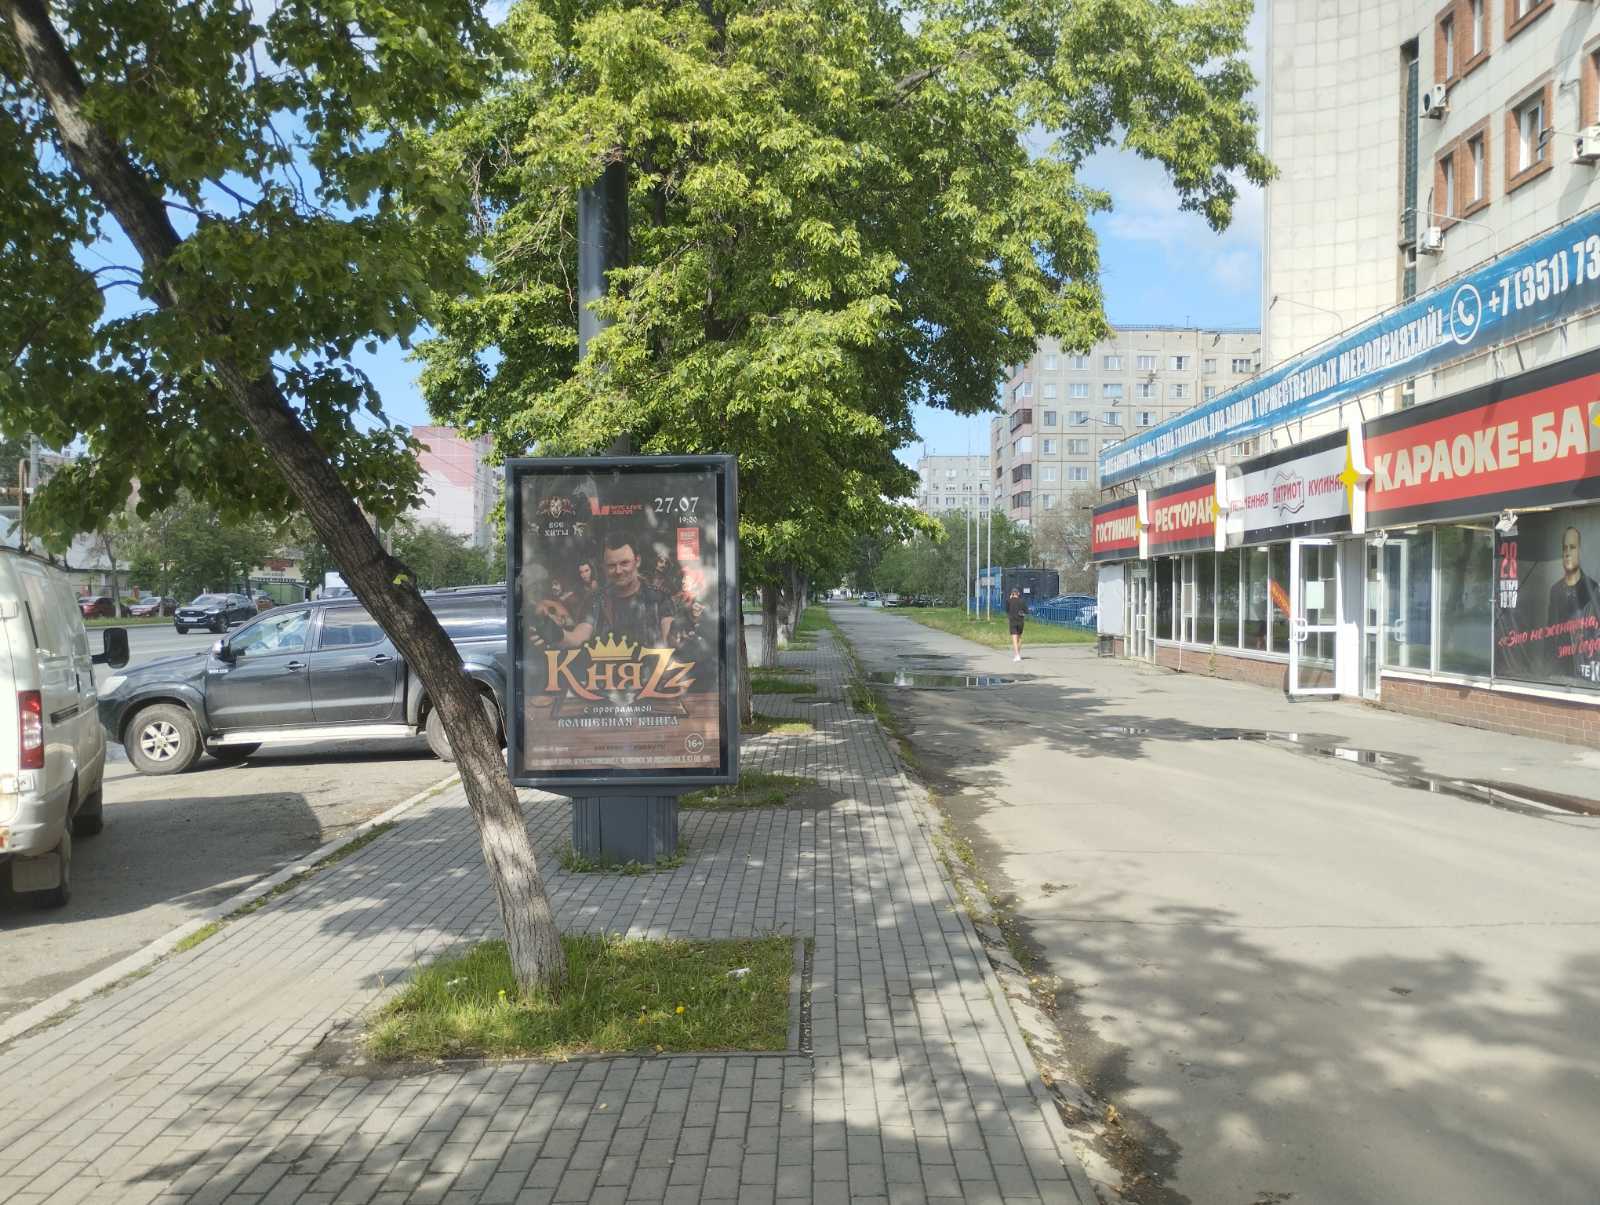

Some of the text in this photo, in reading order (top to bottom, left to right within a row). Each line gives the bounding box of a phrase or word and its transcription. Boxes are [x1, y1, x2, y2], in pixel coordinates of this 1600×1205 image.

[1254, 357, 1338, 418] ТОРЖЕСТВЕННЫХ
[1339, 304, 1443, 382] МЕРОПРИЯТИЙ!
[1488, 276, 1511, 317] +7
[1514, 250, 1569, 310] (351)
[1273, 480, 1302, 503] ПАТРИОТ
[1308, 471, 1344, 497] КУЛИНА
[654, 496, 700, 514] 27.07
[1154, 495, 1215, 533] РЕСТОРАН
[1095, 515, 1138, 544] ГОСТИНИЦ
[592, 704, 652, 716] программой
[557, 716, 680, 729] ВОЛШЕБНАЯ КНИГА
[687, 738, 704, 749] 16+
